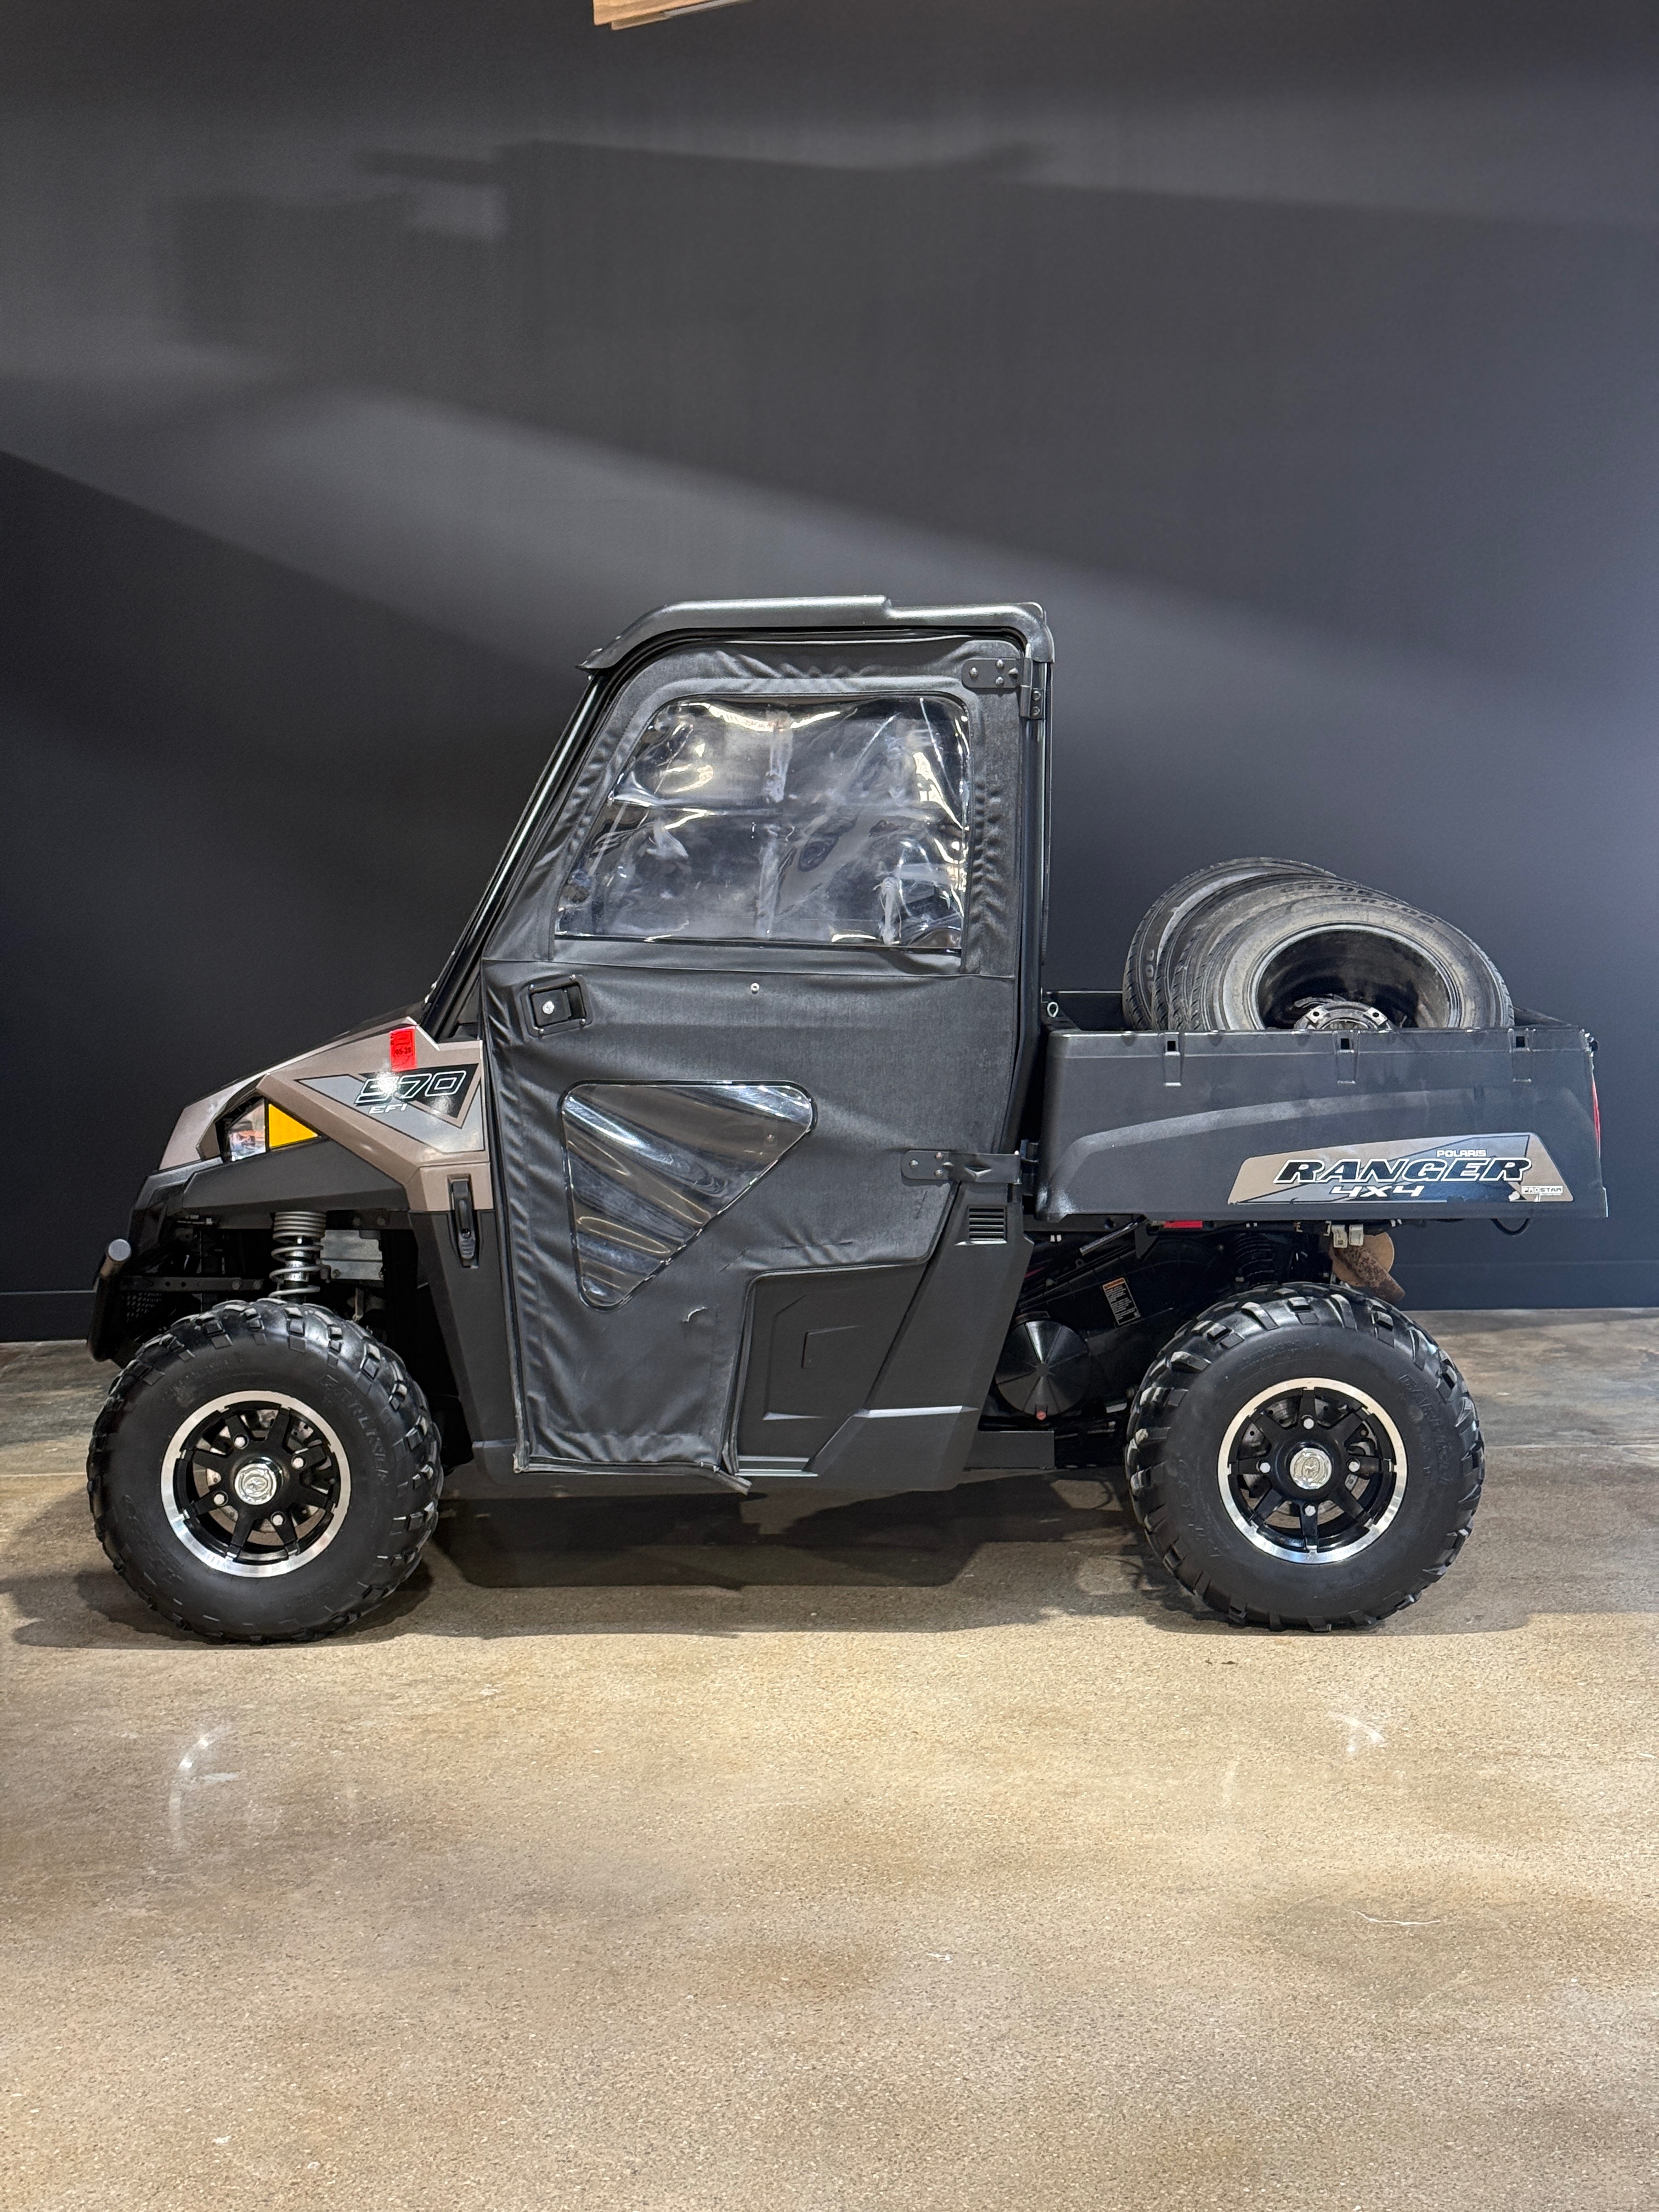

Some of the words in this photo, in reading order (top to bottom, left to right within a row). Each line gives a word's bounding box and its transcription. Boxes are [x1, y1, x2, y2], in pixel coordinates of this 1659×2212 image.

[356, 1070, 466, 1103] 570
[369, 1103, 408, 1114] EFI
[1273, 1157, 1532, 1183] RANGER
